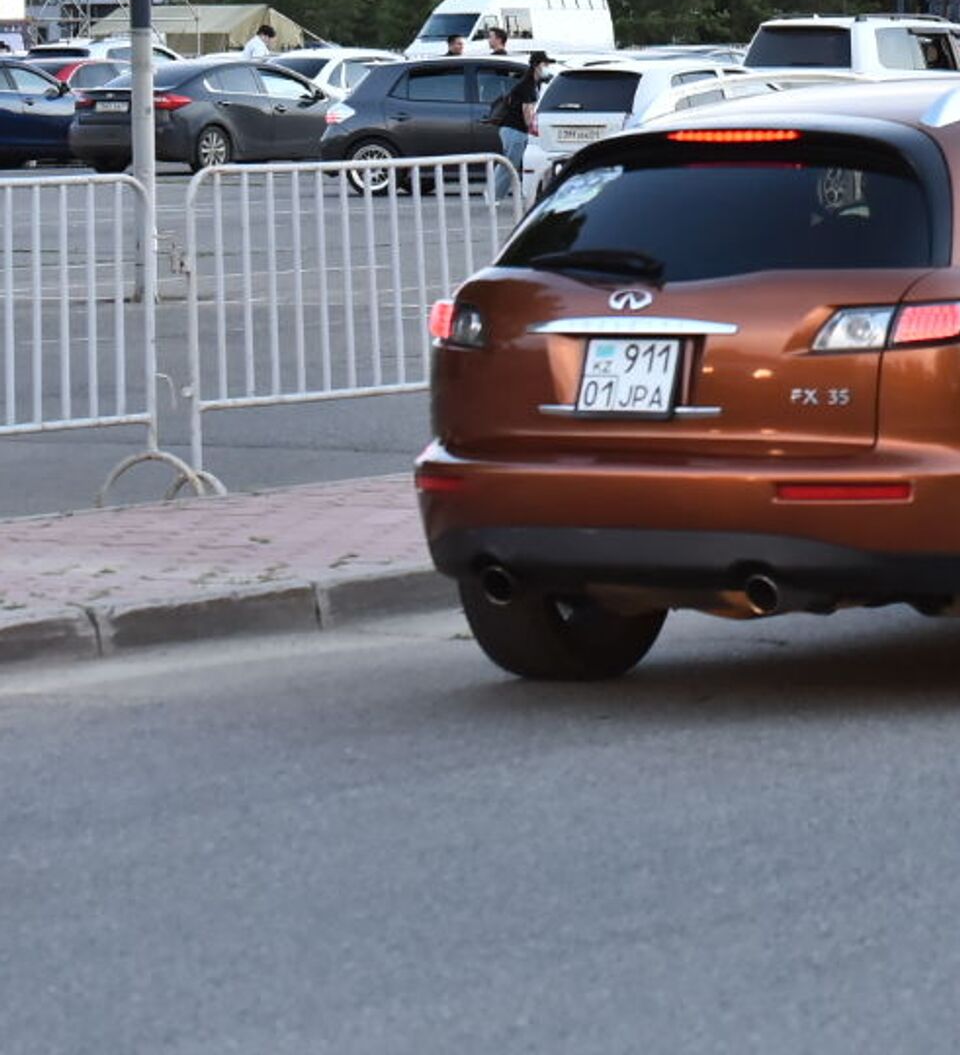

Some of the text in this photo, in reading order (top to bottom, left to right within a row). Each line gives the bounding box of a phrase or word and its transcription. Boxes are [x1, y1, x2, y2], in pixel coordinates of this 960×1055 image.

[624, 343, 671, 374] 911
[584, 380, 663, 408] 01 JPA
[790, 387, 850, 406] FX 35
